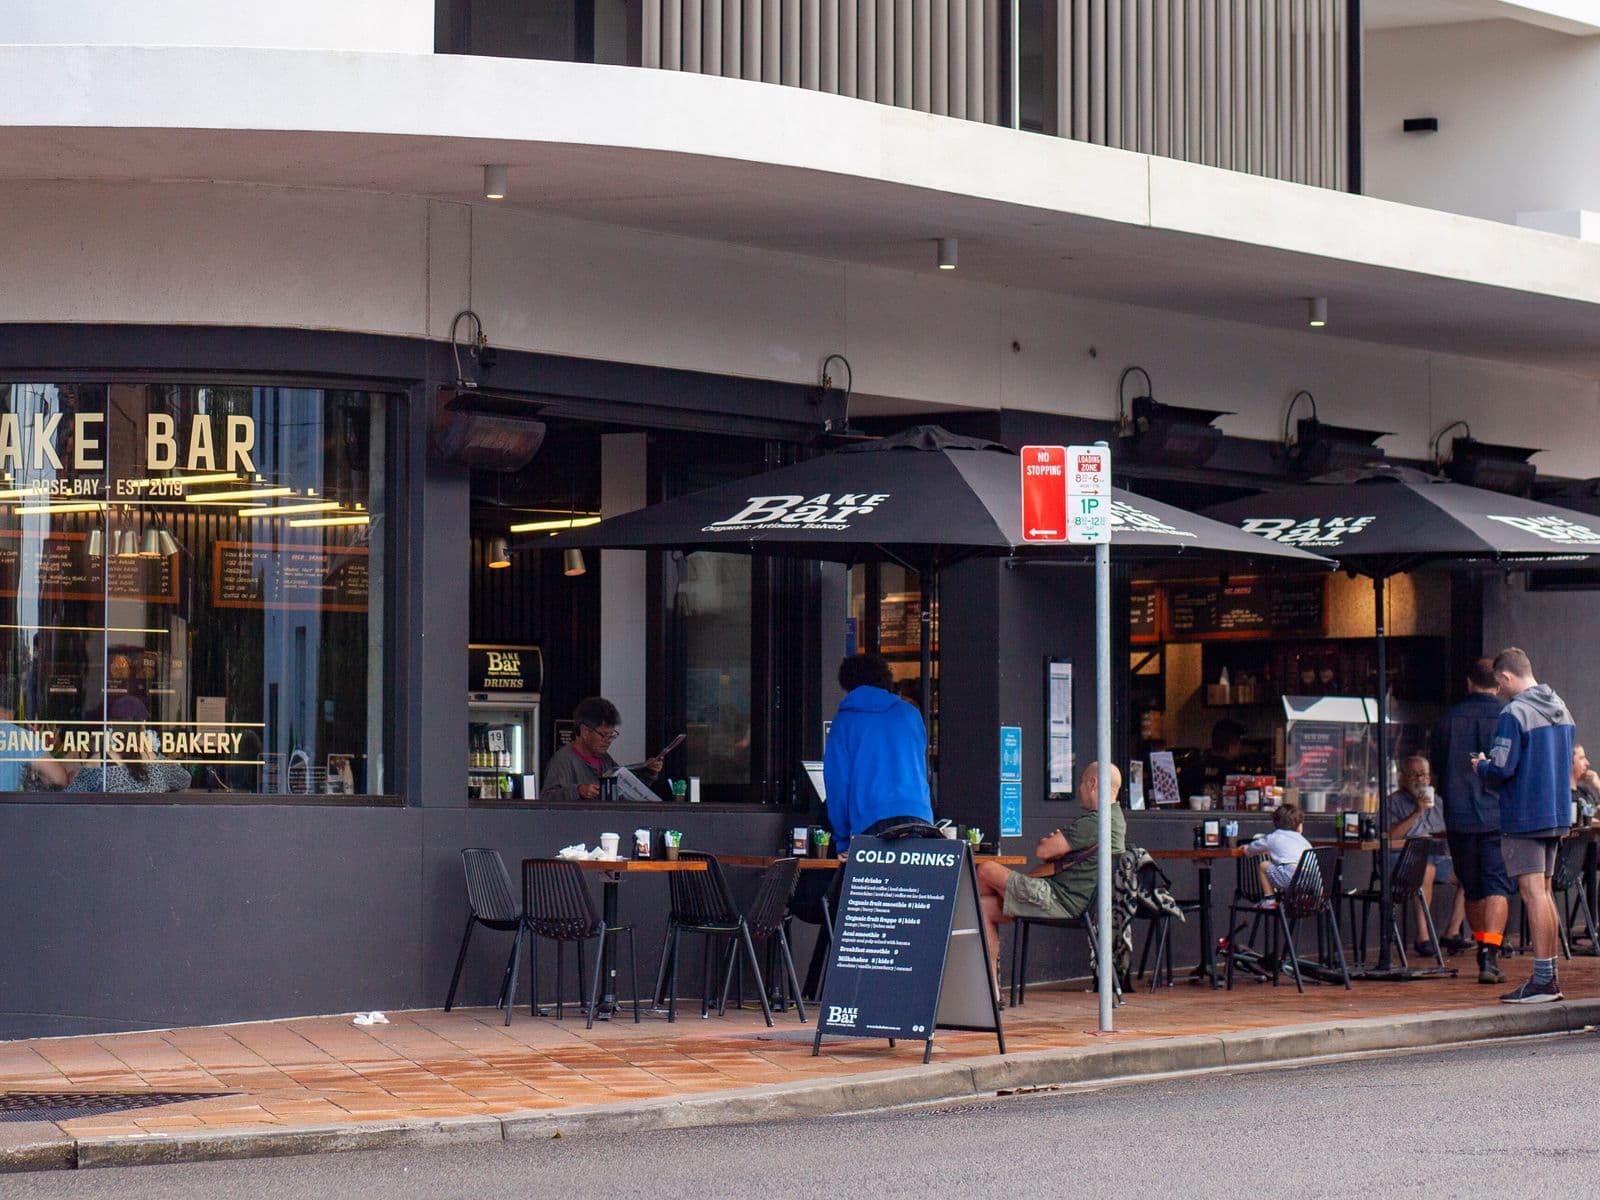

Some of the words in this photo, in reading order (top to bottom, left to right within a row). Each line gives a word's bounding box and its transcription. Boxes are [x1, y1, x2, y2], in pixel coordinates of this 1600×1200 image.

[0, 412, 104, 470] AKE
[147, 413, 257, 472] BAR
[1037, 453, 1049, 462] NO
[1078, 455, 1100, 463] LOADING
[1027, 465, 1061, 476] STOPPING
[1080, 464, 1098, 472] ZONE
[32, 479, 68, 496] ROSE
[74, 479, 100, 496] BAY
[117, 479, 142, 496] EST
[149, 480, 183, 496] 2019
[1081, 498, 1099, 514] 1P
[702, 524, 752, 532] Organic
[802, 522, 850, 530] Bakery
[484, 678, 524, 688] DRINKS
[63, 730, 153, 753] ARTISAN
[162, 731, 243, 754] BAKERY
[856, 850, 896, 864] COLD
[900, 852, 955, 867] DRINKS
